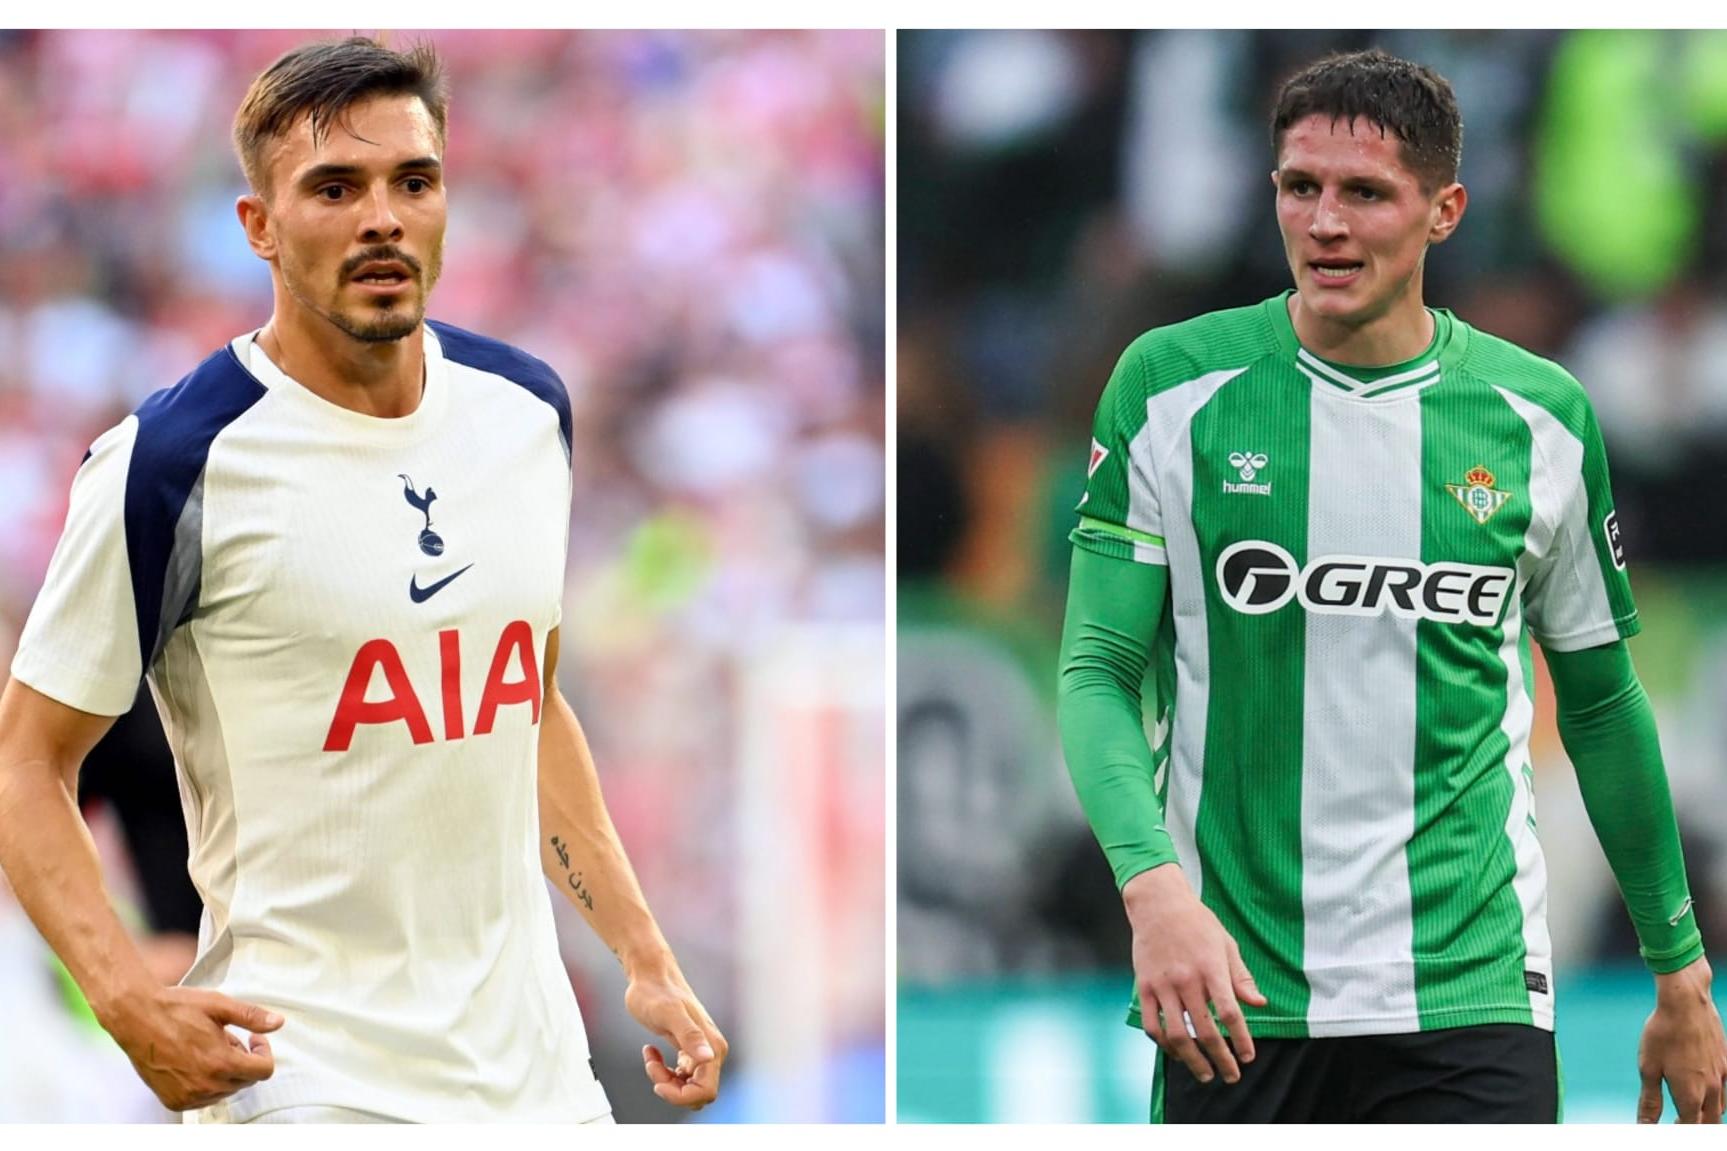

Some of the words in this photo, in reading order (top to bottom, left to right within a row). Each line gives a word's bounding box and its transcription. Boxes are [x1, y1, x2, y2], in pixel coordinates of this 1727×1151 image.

[1223, 478, 1271, 496] hummel
[1305, 563, 1508, 617] GREE
[322, 620, 541, 752] AIA
